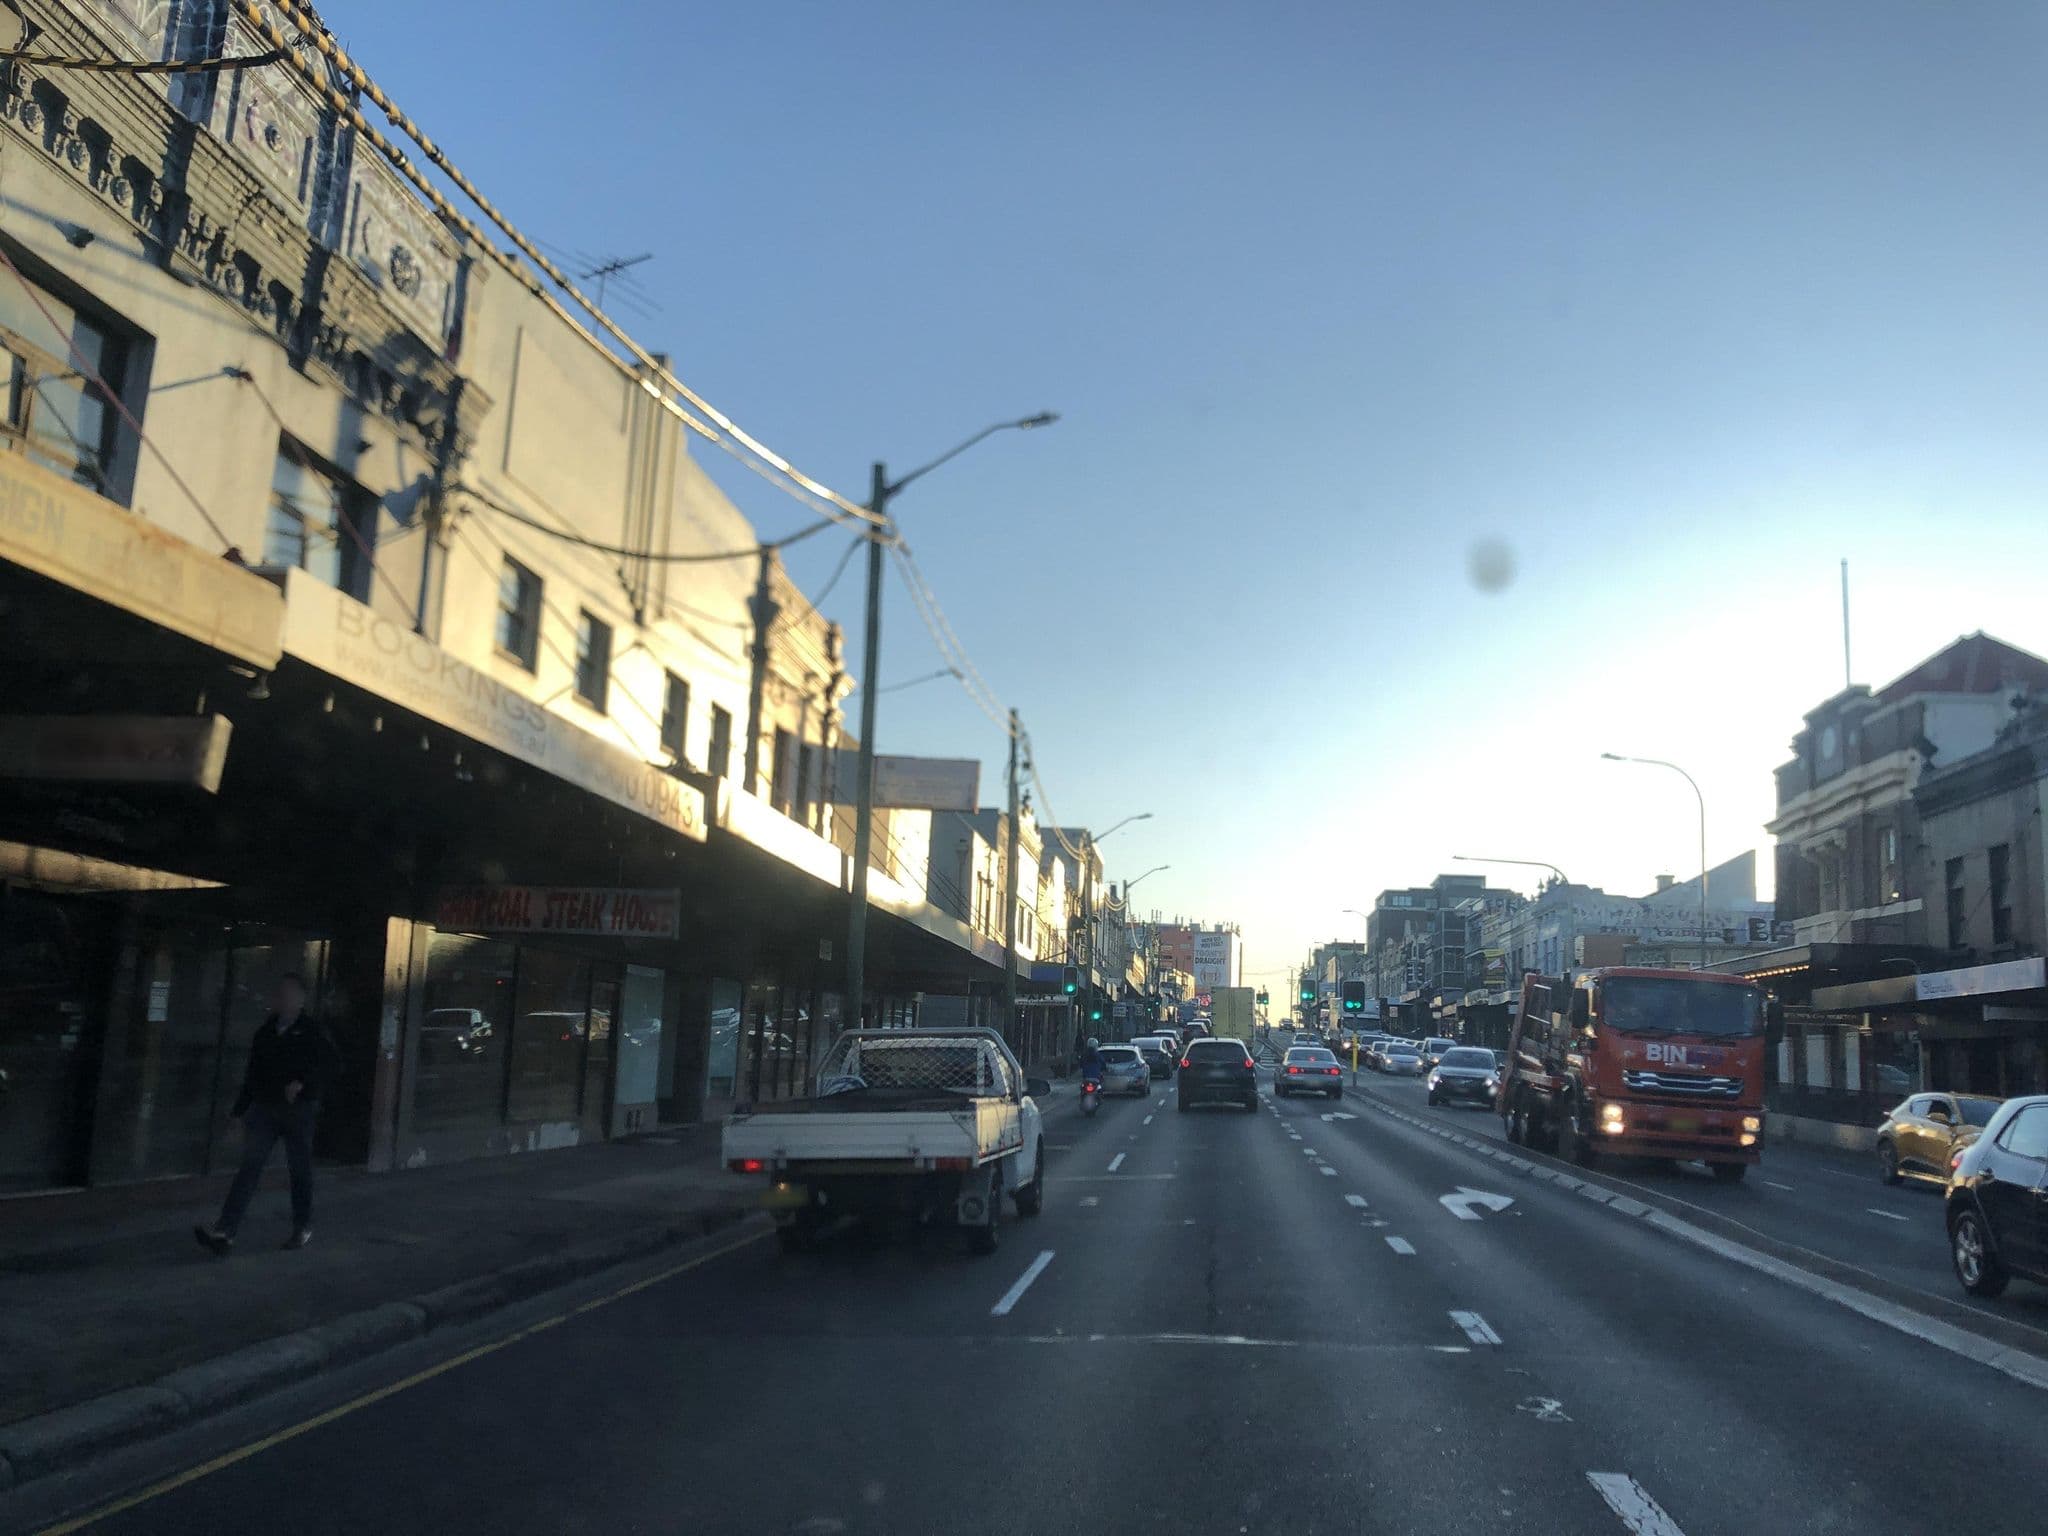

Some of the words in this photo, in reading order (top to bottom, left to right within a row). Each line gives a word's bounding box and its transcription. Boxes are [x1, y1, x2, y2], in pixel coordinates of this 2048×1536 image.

[337, 597, 547, 732] BOOKINGS
[543, 891, 606, 930] STEAK
[1647, 1043, 1687, 1064] BIN
